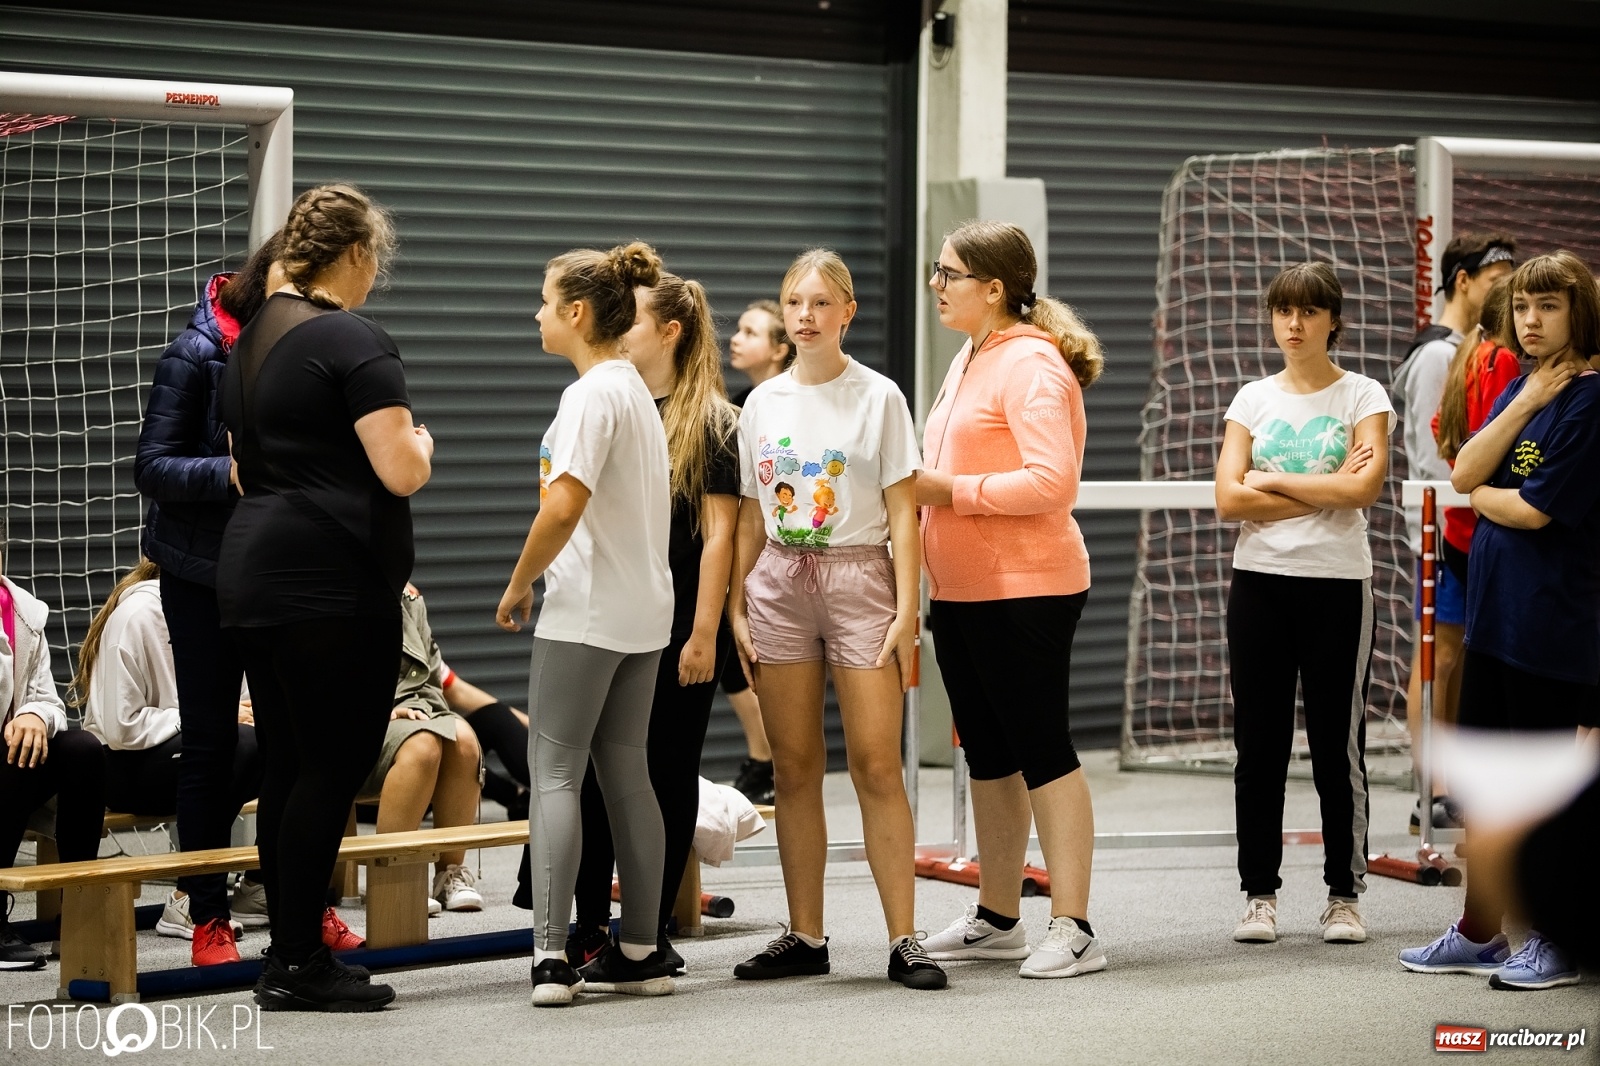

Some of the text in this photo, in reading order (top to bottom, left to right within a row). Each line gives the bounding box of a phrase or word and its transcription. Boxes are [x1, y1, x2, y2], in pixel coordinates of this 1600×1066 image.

[165, 92, 221, 107] PESMENPOL
[1278, 438, 1314, 449] SALTY
[1278, 450, 1314, 461] VIBES
